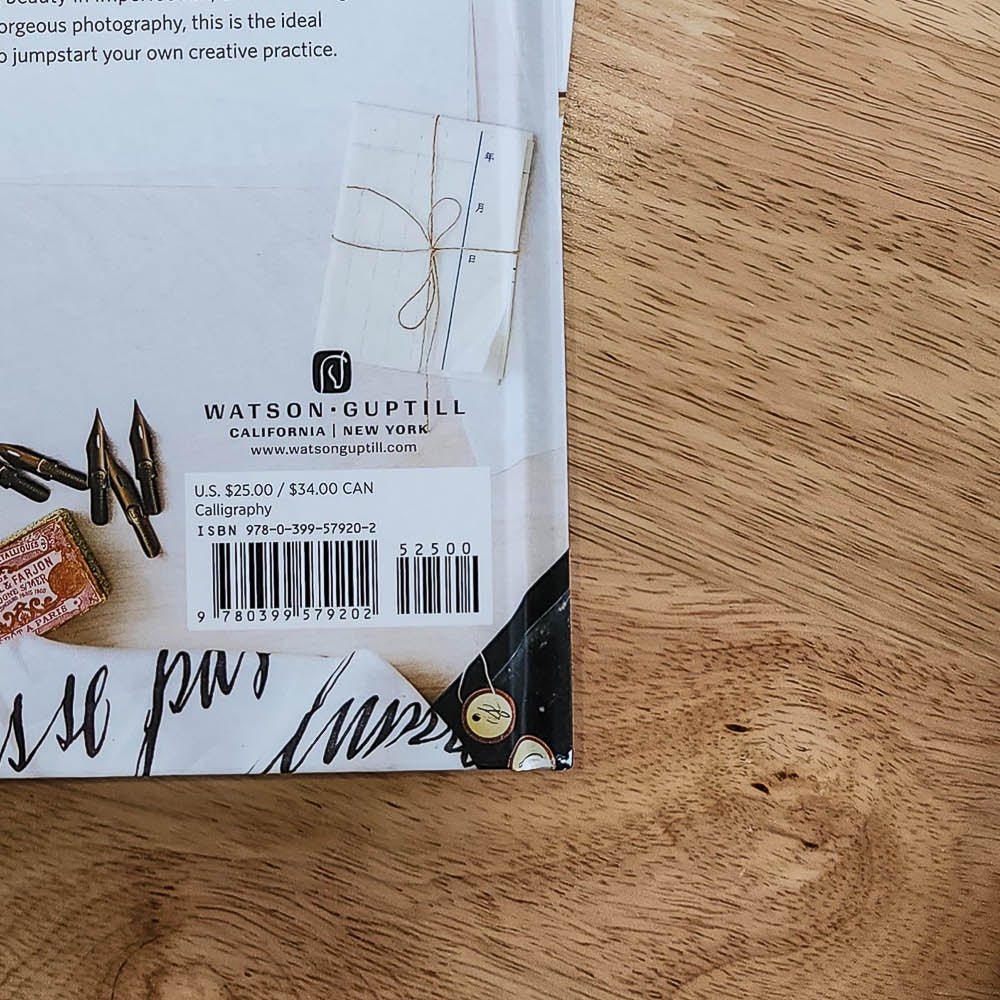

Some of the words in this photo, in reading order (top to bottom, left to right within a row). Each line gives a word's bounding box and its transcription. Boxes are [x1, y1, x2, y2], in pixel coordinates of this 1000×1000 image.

[72, 13, 187, 37] photography,
[191, 12, 224, 31] this
[228, 13, 243, 30] is
[246, 11, 276, 30] the
[281, 10, 322, 29] ideal
[11, 45, 98, 68] jumpstart
[102, 48, 142, 66] your
[146, 47, 184, 61] own
[188, 42, 258, 60] creative
[263, 41, 338, 63] practice.
[229, 426, 326, 439] CALIFORNIA
[343, 425, 380, 436] NEW
[385, 424, 429, 436] YORK
[250, 442, 417, 456] www.watsonguptill.com
[194, 484, 221, 499] U.S.
[225, 483, 273, 498] $25.00
[289, 482, 338, 497] $34.00
[342, 481, 374, 495] CAN
[195, 503, 272, 518] Calligraphy
[197, 525, 237, 537] ISBN
[246, 522, 377, 536] 978-0-399-57920-2
[1, 579, 12, 592] &
[11, 556, 54, 584] FARJON
[34, 605, 68, 627] PARIS
